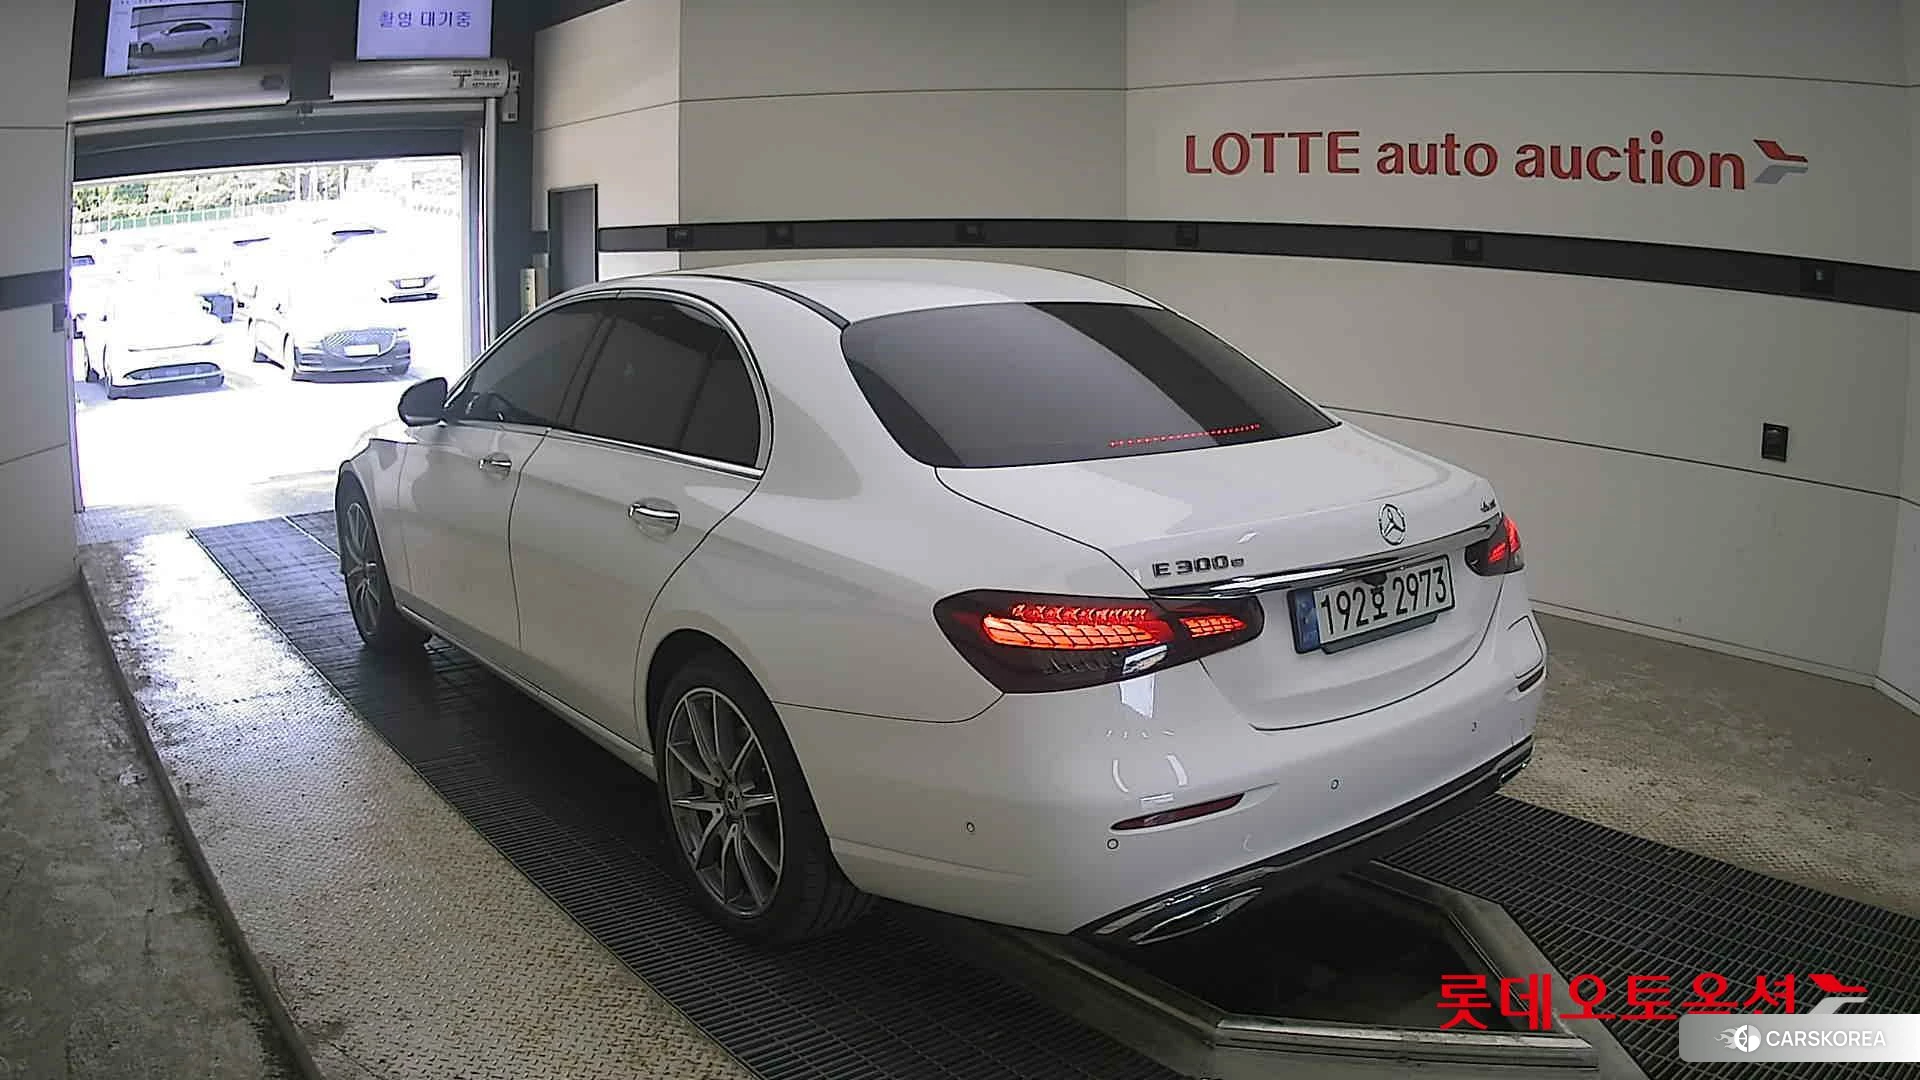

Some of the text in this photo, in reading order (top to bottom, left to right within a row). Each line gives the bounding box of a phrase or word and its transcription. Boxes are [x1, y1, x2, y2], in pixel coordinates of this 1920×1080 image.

[421, 11, 471, 28] 대기중
[1185, 130, 1745, 190] LOTTE auto auction
[1152, 562, 1171, 577] E
[1393, 566, 1447, 616] 2973
